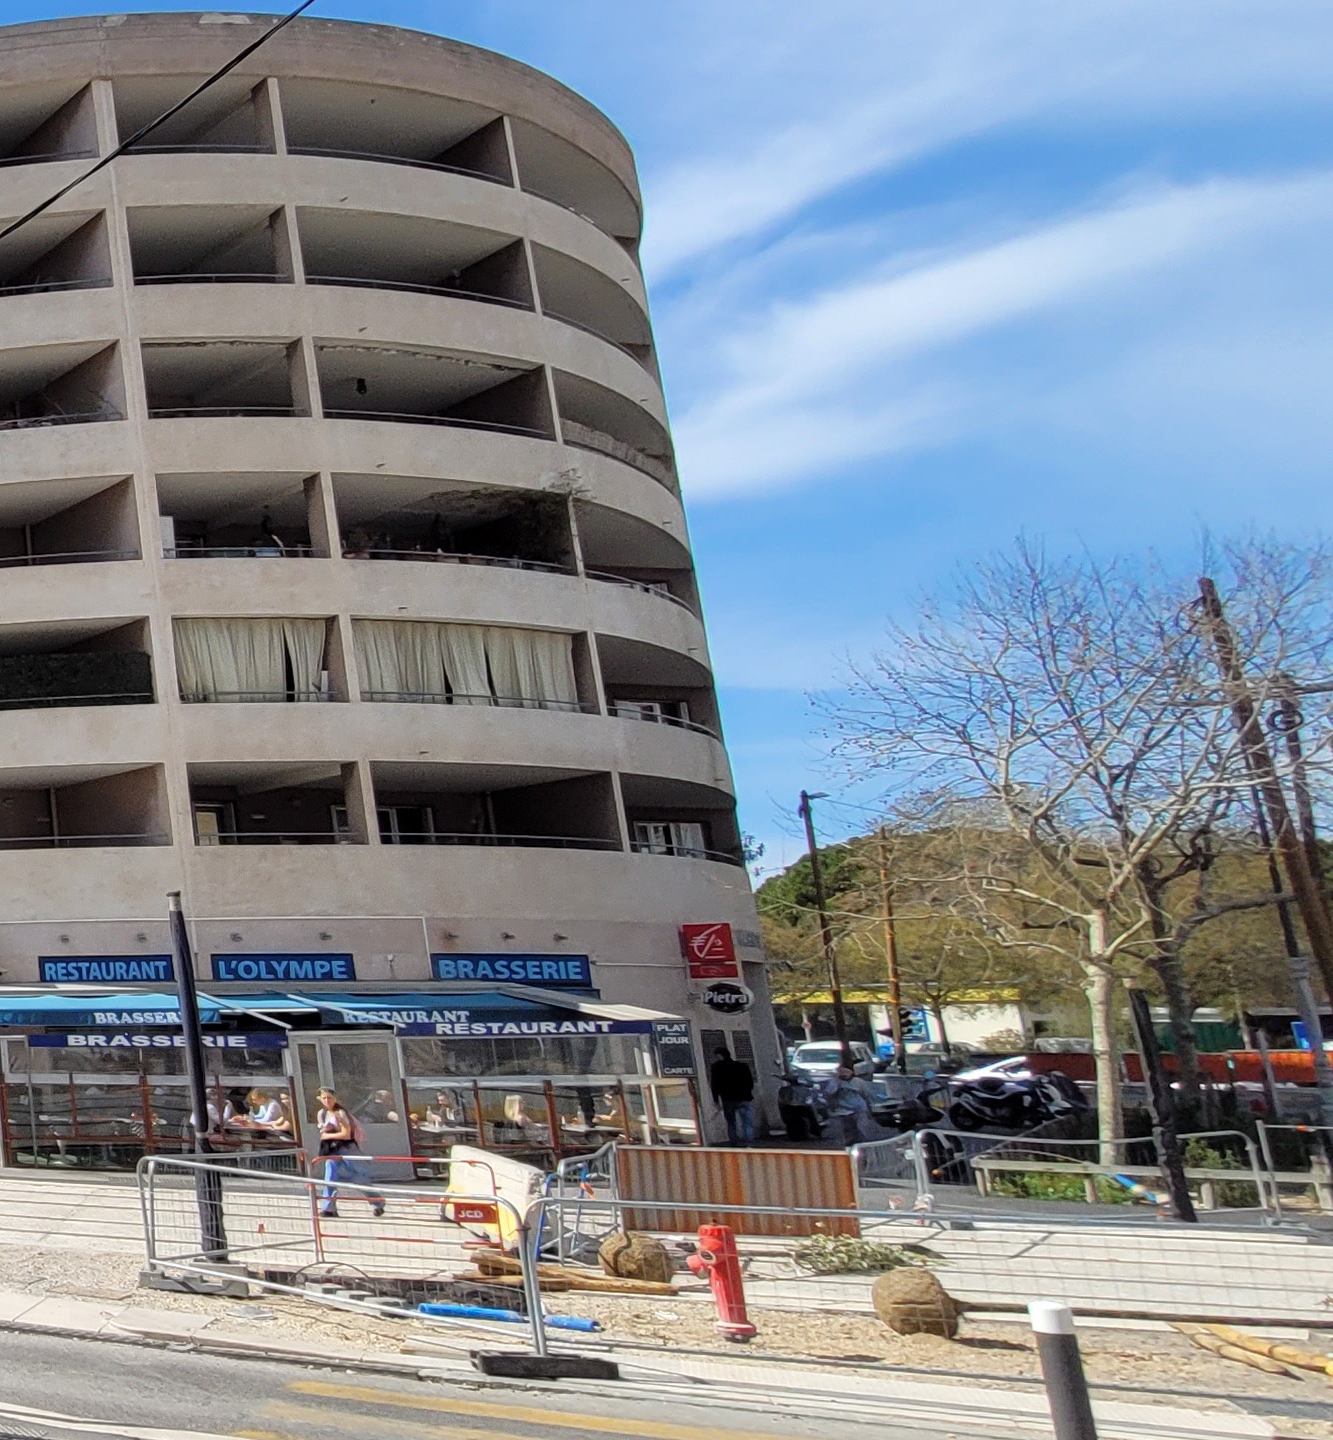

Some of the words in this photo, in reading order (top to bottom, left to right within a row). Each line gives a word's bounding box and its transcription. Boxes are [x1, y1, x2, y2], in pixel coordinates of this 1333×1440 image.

[44, 961, 167, 981] RESTAURANT
[218, 960, 348, 980] L'OLYMPE
[438, 960, 584, 980] BRASSERIE
[704, 991, 748, 1004] Pietra
[93, 1012, 182, 1024] BRASSER
[341, 1010, 470, 1024] RESTAURANT
[435, 1021, 614, 1035] RESTAURANT
[656, 1024, 687, 1032] PLAT
[66, 1034, 248, 1047] BRASSERIE
[659, 1036, 690, 1044] JOUR
[663, 1067, 694, 1075] CARTE
